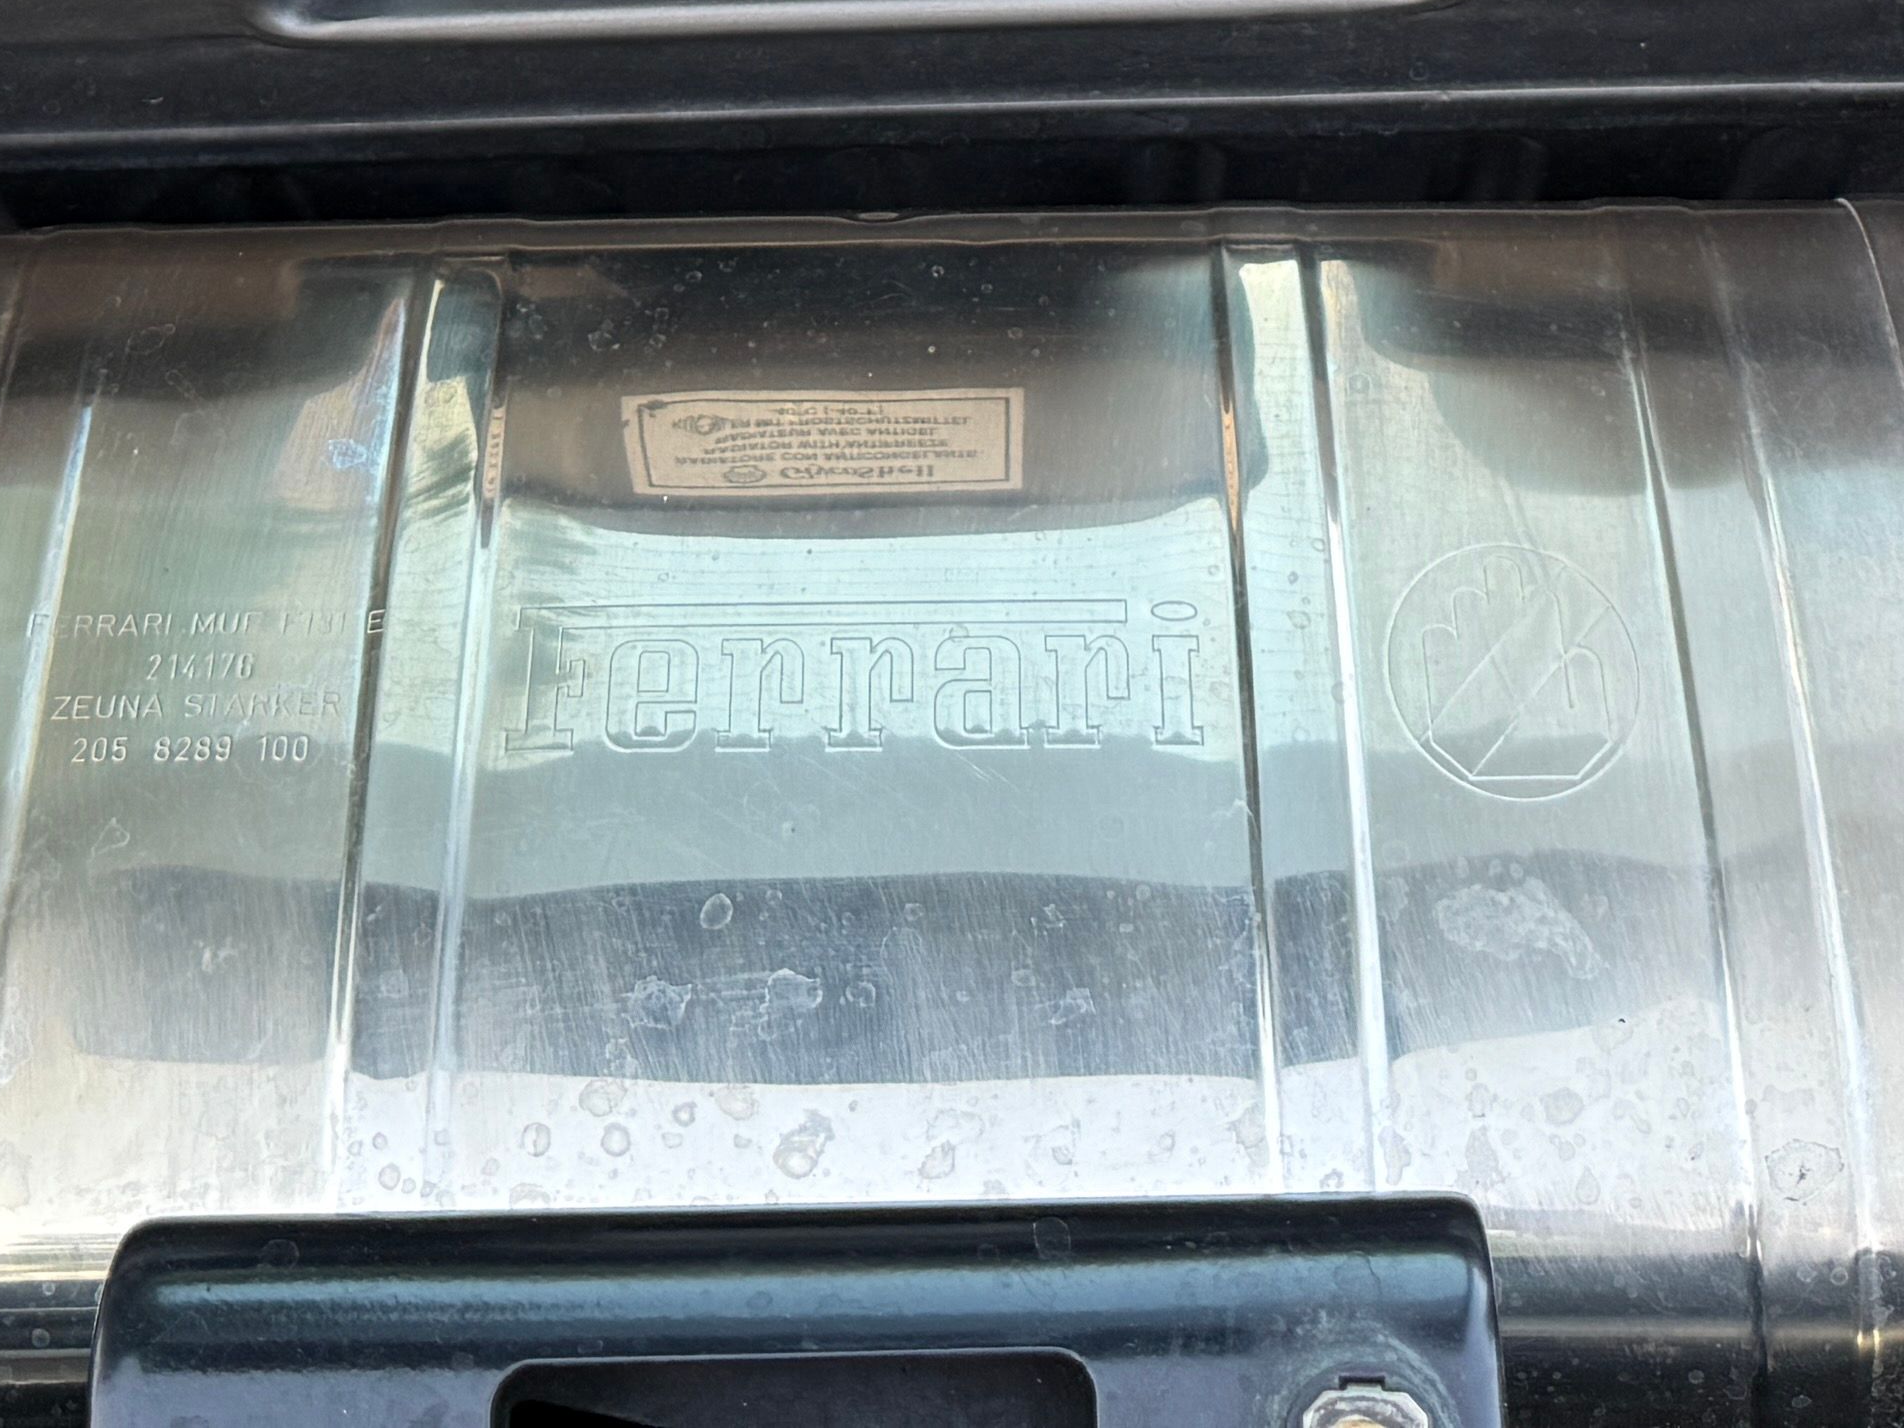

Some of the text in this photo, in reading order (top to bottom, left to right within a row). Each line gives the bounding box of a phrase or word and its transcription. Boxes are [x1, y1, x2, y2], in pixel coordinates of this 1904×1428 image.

[504, 598, 1205, 753] Ferrari
[50, 695, 165, 721] ZEUNA
[71, 735, 309, 763] 205 8289 100
